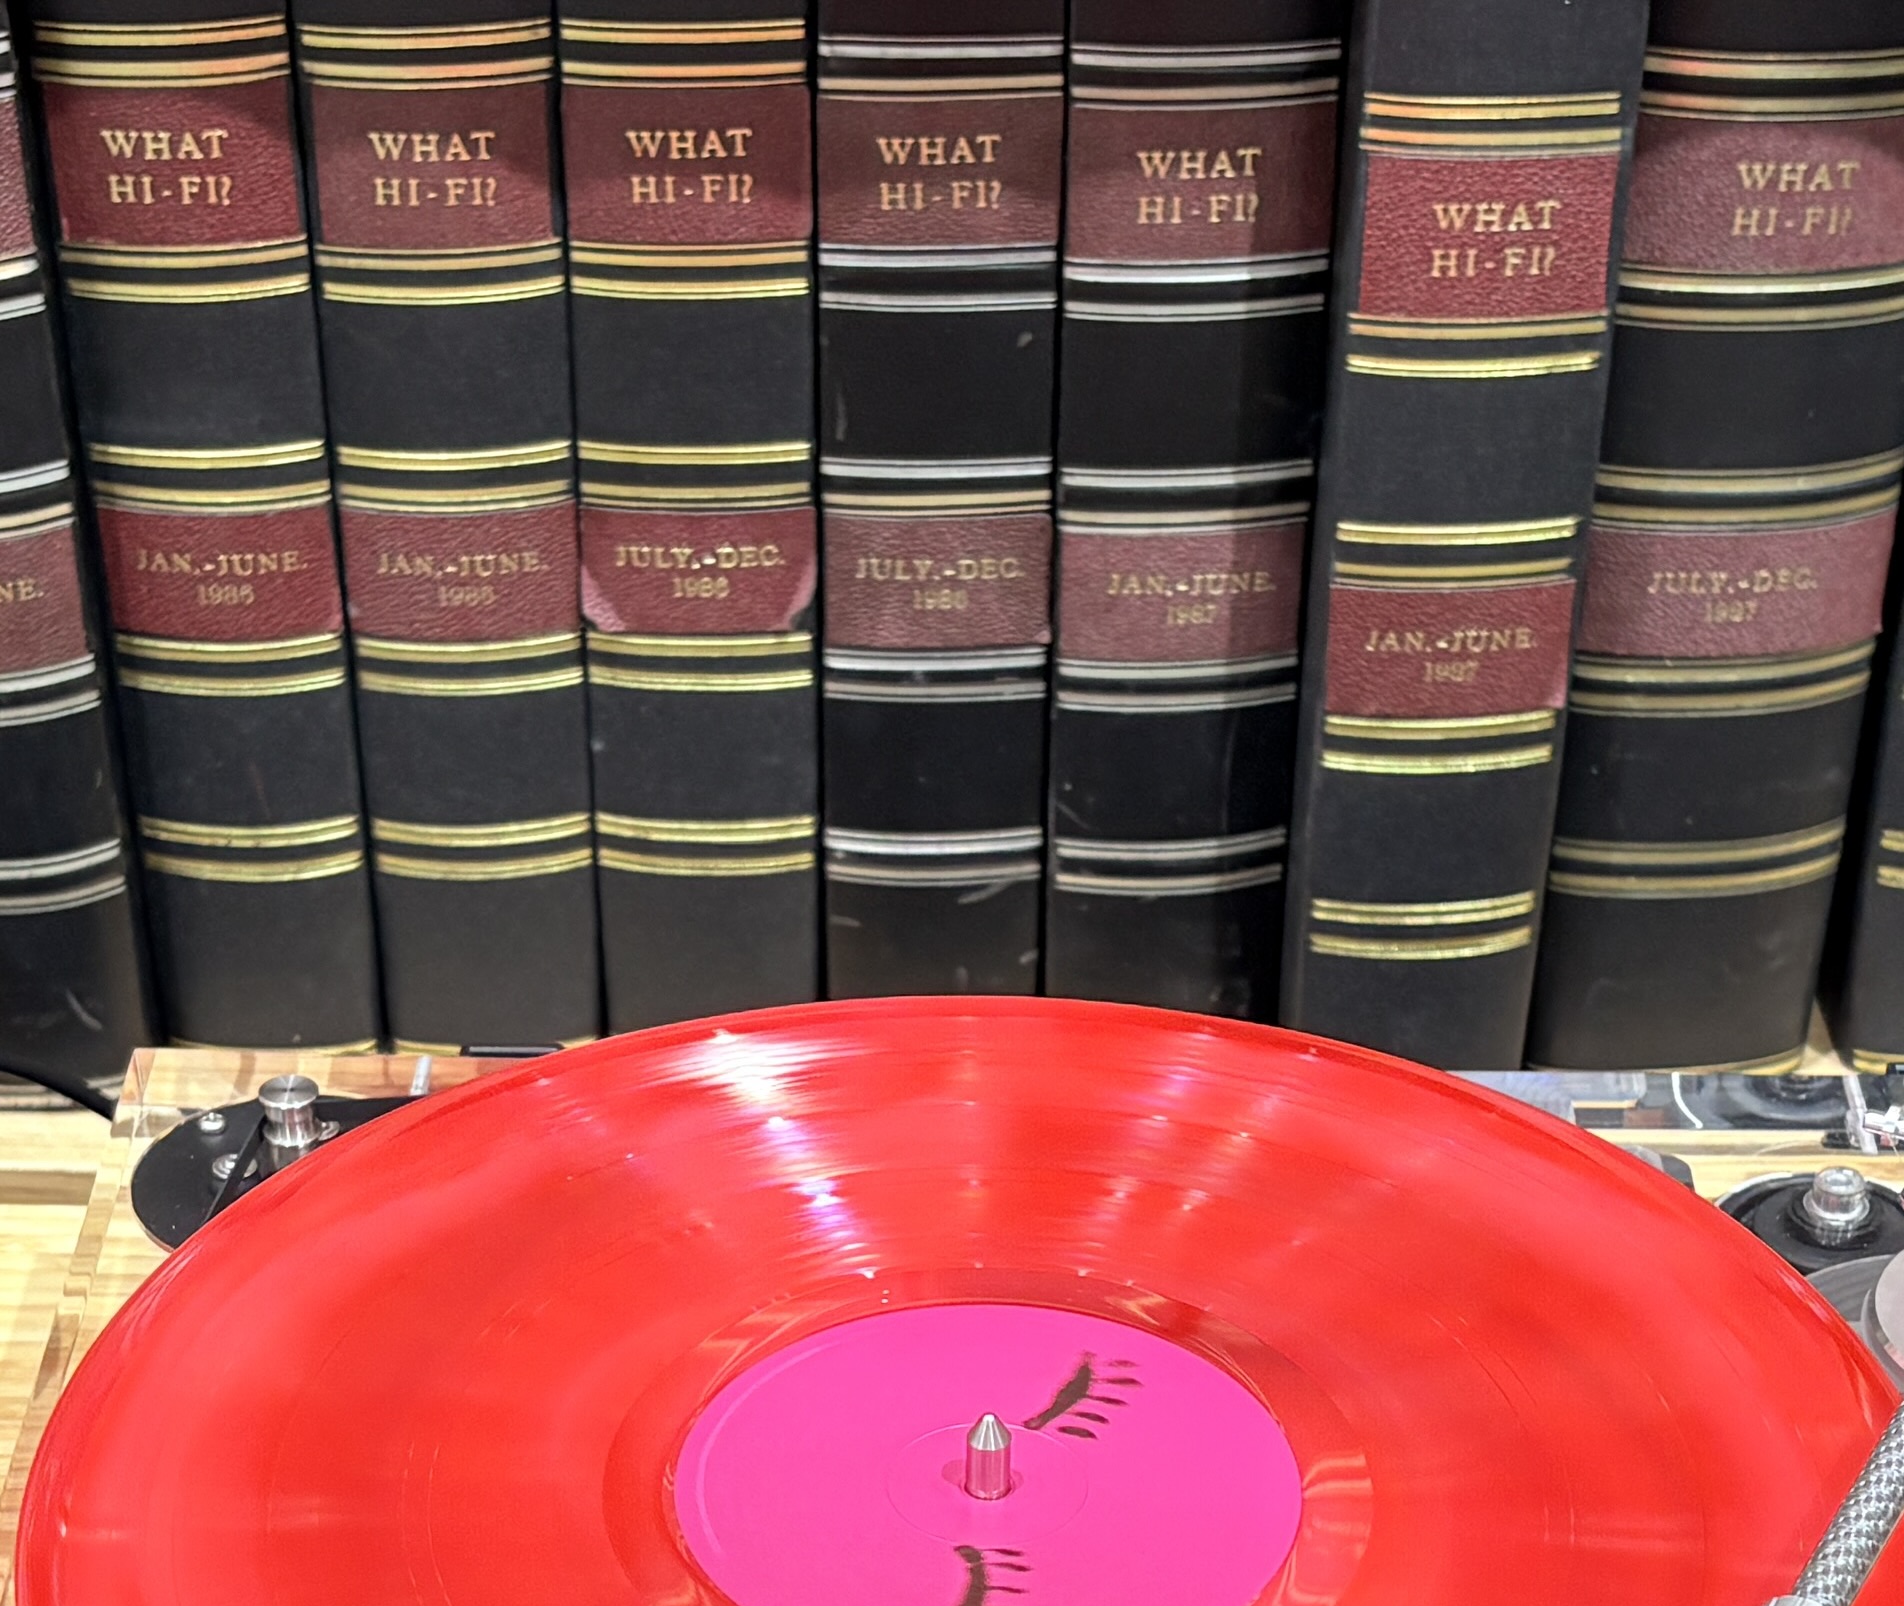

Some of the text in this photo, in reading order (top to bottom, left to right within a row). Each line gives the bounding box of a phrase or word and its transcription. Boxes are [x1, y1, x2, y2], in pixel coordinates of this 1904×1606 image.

[101, 130, 229, 161] WHAT
[368, 131, 496, 162] WHAT
[625, 128, 752, 159] WHAT
[876, 135, 1002, 166] WHAT
[1136, 147, 1261, 180] WHAT
[1737, 161, 1861, 194] WHAT
[108, 175, 232, 206] HI-FI?
[374, 177, 497, 207] HI-FI?
[630, 172, 754, 205] HI-FI?
[878, 181, 1002, 211] HI-FI?
[1137, 194, 1260, 225] HI-FI?
[1432, 200, 1562, 235] WHAT
[1731, 205, 1853, 238] HI-FI?
[1430, 243, 1557, 279] HI-FI?
